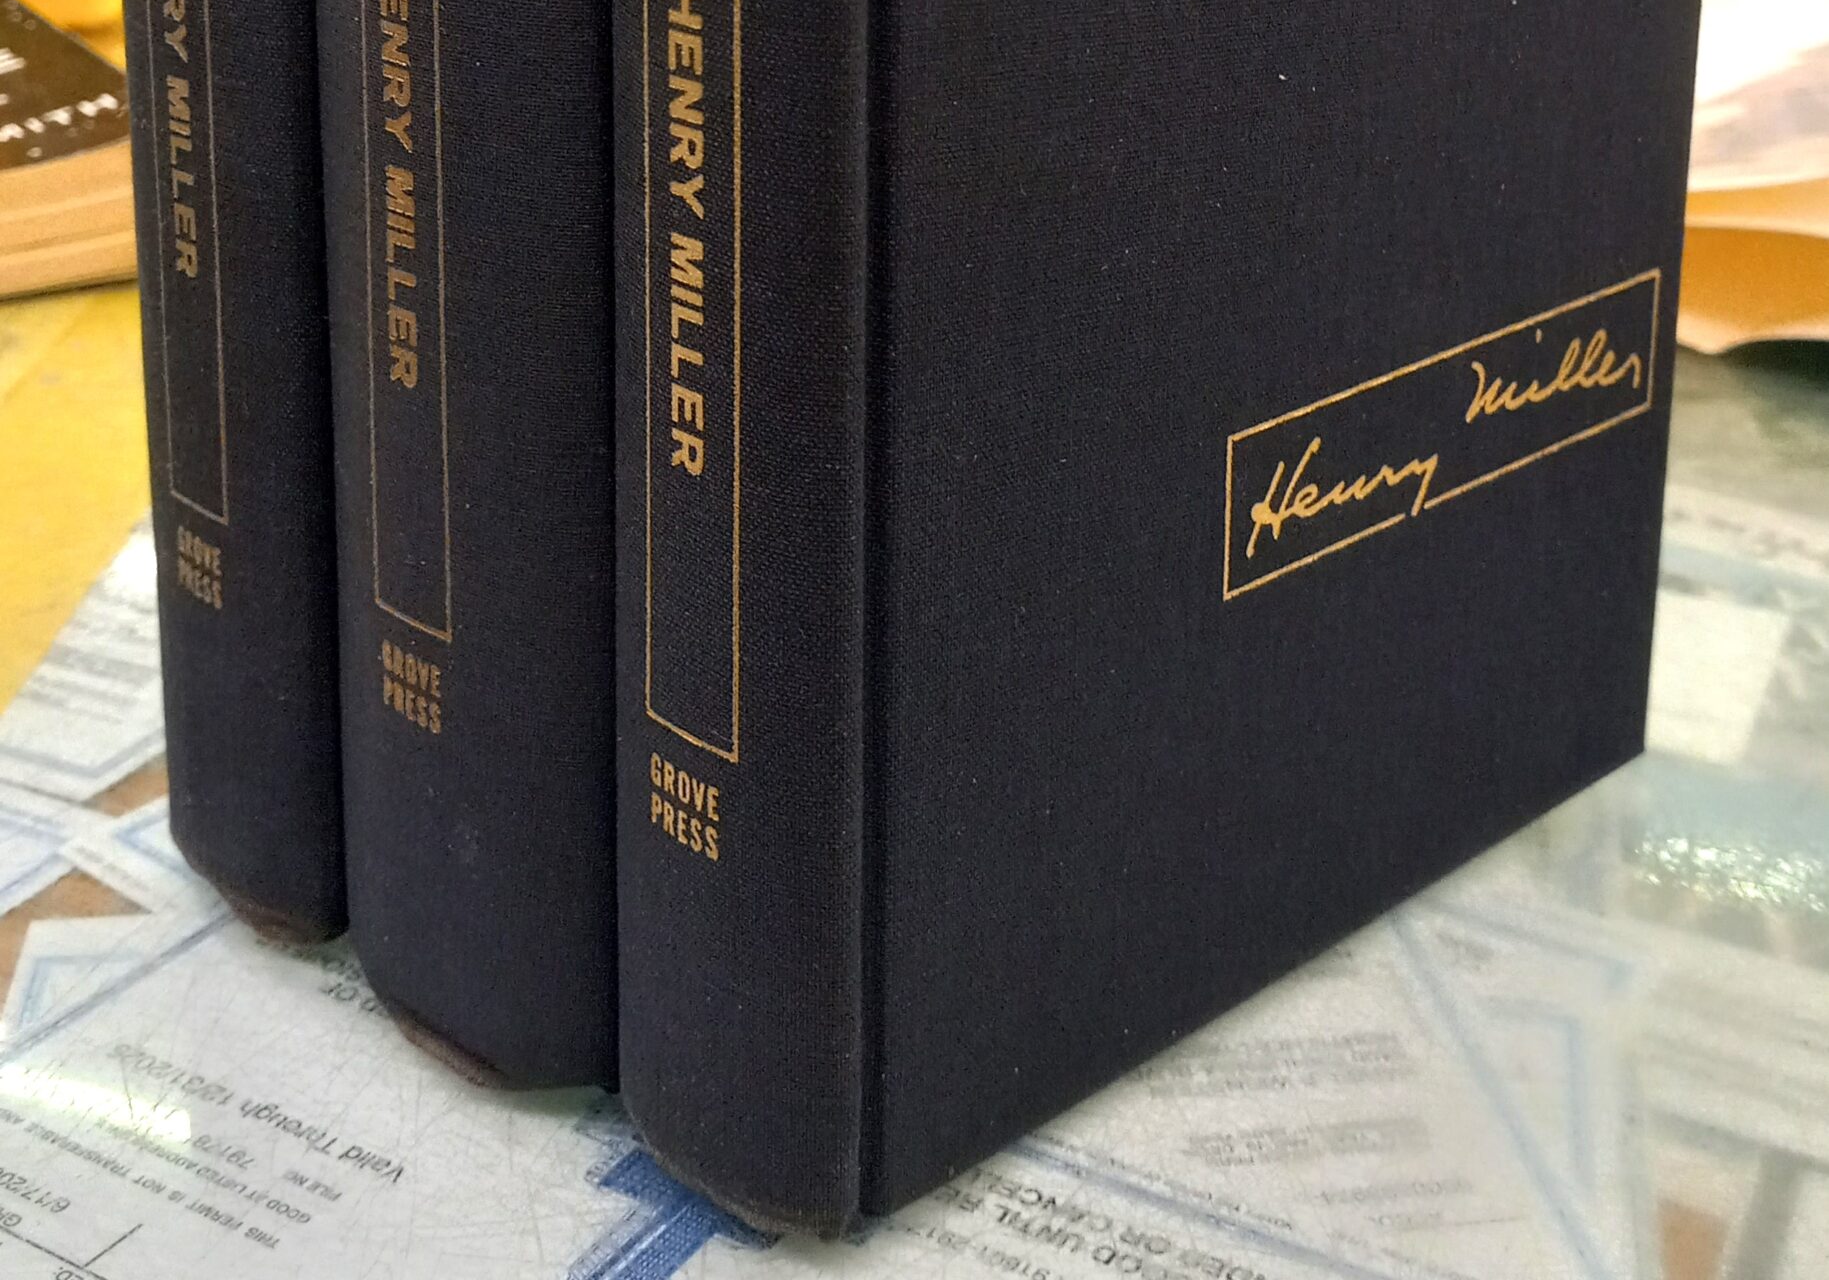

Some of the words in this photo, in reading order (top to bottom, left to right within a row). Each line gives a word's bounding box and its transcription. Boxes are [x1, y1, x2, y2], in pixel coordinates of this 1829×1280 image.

[166, 74, 198, 280] MILLER
[385, 164, 418, 390] MILLER
[669, 232, 705, 478] MILLER
[1246, 436, 1438, 559] Henry
[1466, 328, 1641, 423] Miller
[178, 526, 221, 577] GROVE
[178, 554, 222, 609] PRESS
[382, 639, 440, 698] GROVE
[383, 673, 441, 735] PRESS
[651, 752, 719, 821] GROVE
[651, 792, 719, 861] PRESS
[240, 1101, 338, 1155] Through
[0, 1167, 71, 1213] 6/17/20
[133, 1175, 167, 1195] NOT
[338, 1145, 404, 1183] Valid
[167, 1190, 187, 1202] IS
[185, 1198, 244, 1231] PERMIT
[267, 1198, 311, 1224] GOOD
[244, 1226, 280, 1250] THIS
